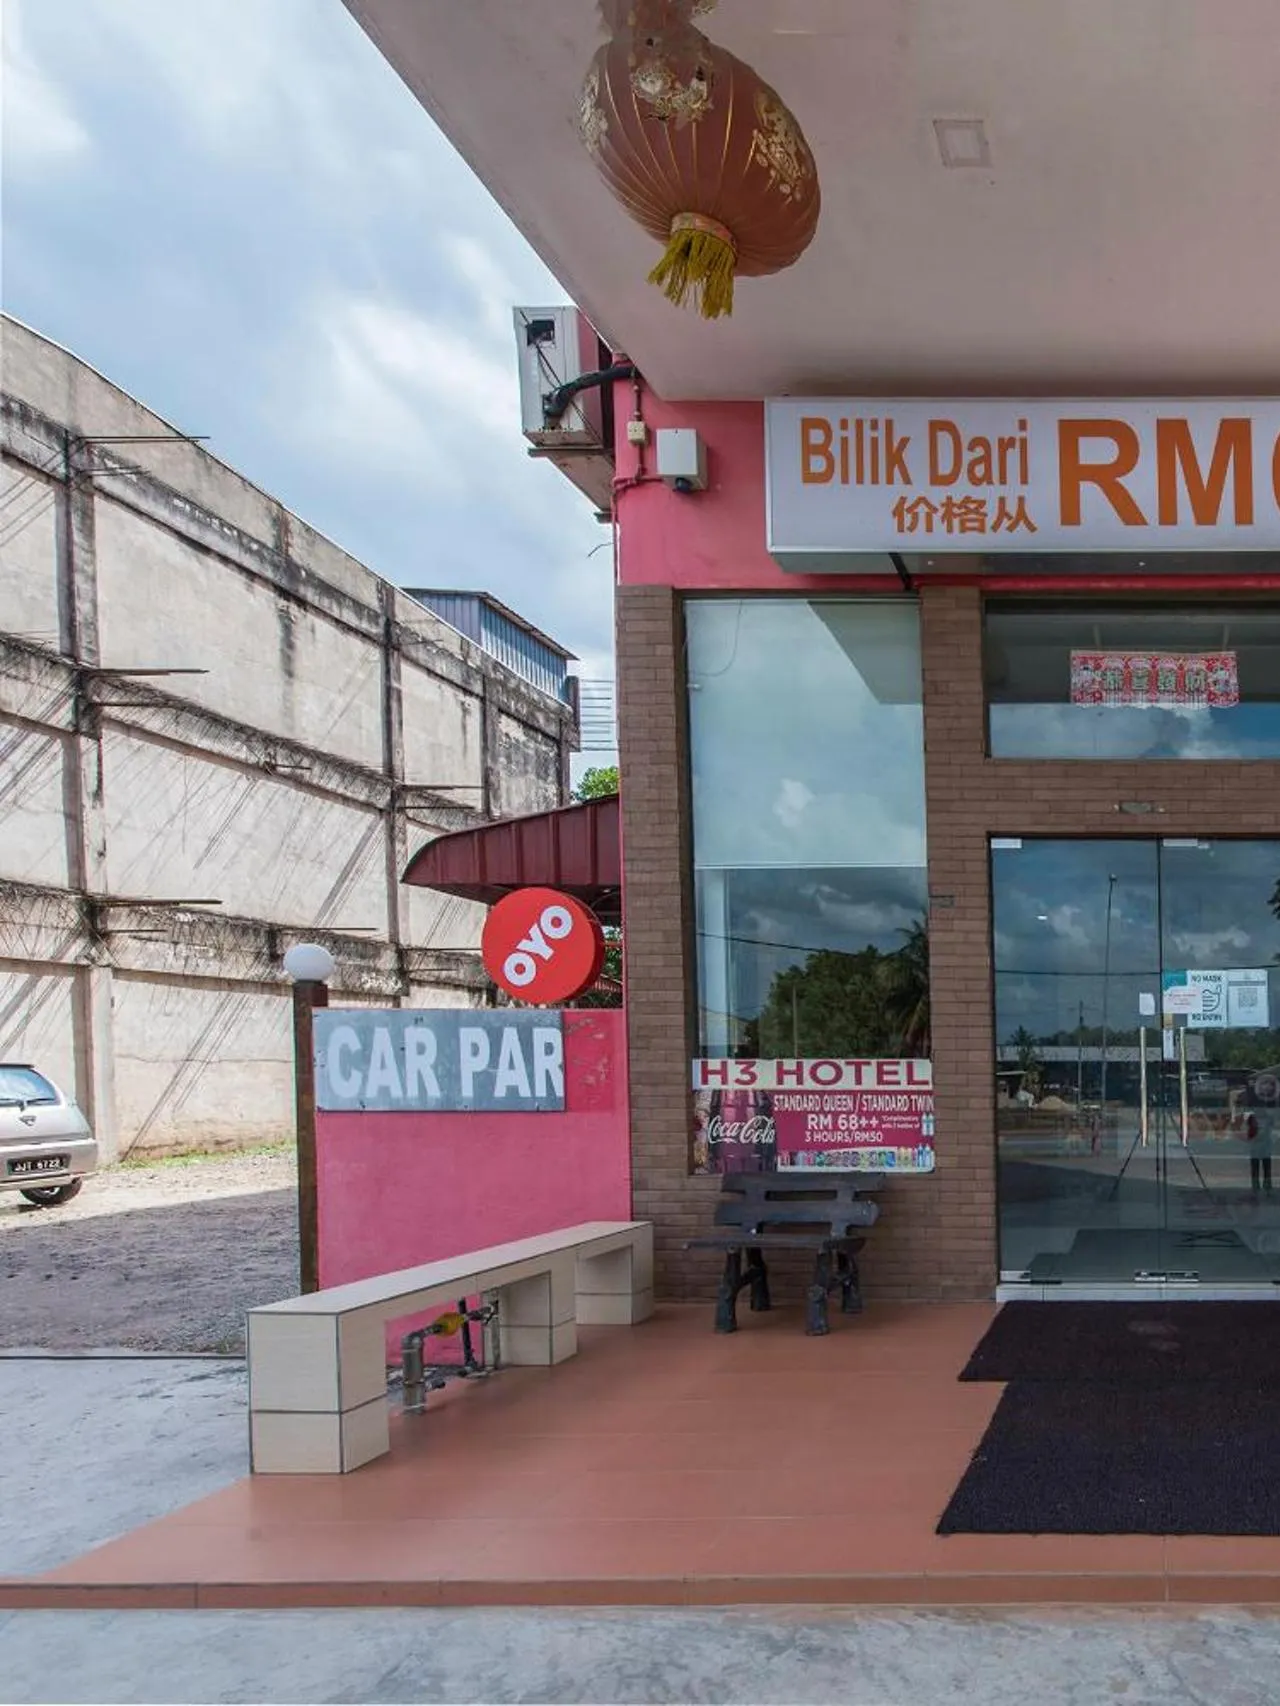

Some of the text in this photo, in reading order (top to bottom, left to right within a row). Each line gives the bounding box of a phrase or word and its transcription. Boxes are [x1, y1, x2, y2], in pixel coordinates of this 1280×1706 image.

[800, 416, 1030, 486] Bilik Dari
[891, 494, 1039, 534] 价格从
[503, 905, 573, 986] OYO
[326, 1025, 565, 1099] CAR PAR
[700, 1060, 930, 1086] H3 HOTEL
[773, 1095, 821, 1111] STANDARD
[823, 1095, 854, 1111] QUEEN
[862, 1095, 909, 1111] STANDARD
[805, 1131, 812, 1142] 3
[807, 1116, 833, 1130] RM
